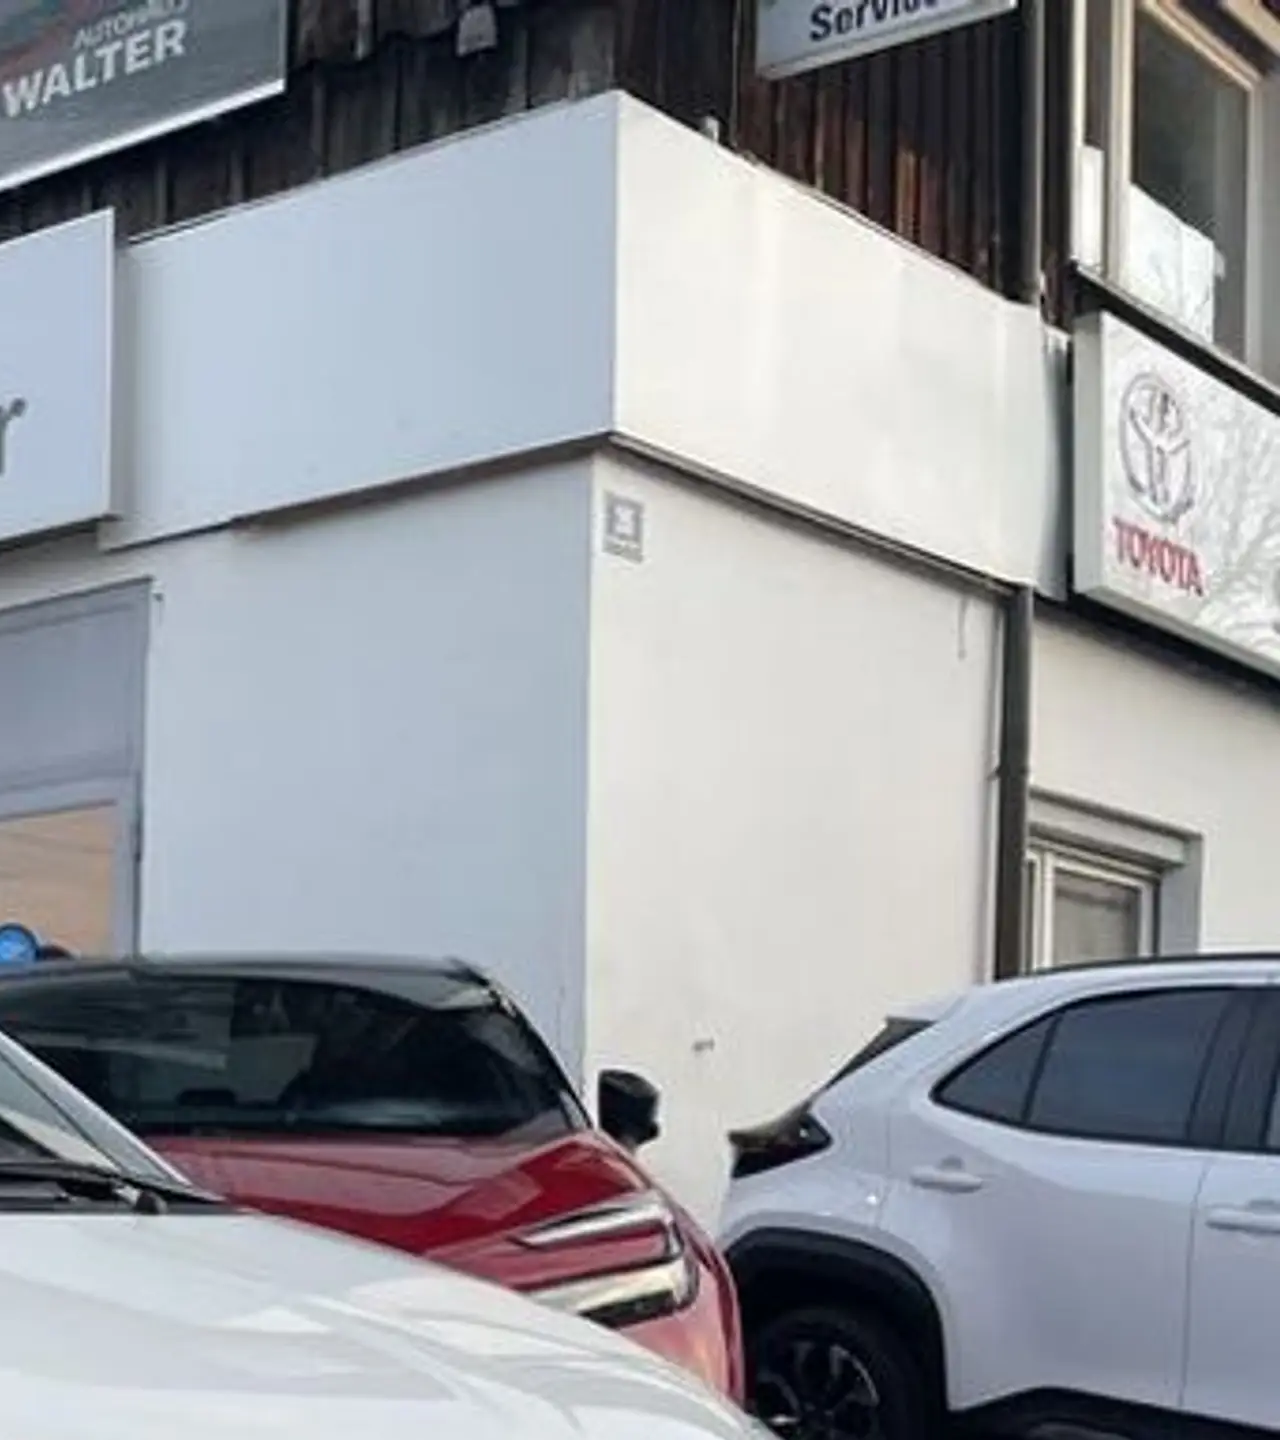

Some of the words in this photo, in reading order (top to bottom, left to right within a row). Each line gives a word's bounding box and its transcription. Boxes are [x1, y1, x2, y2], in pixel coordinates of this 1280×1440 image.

[810, 0, 942, 41] Servi
[2, 19, 186, 117] WALTER
[1112, 516, 1204, 597] TOYOTA
